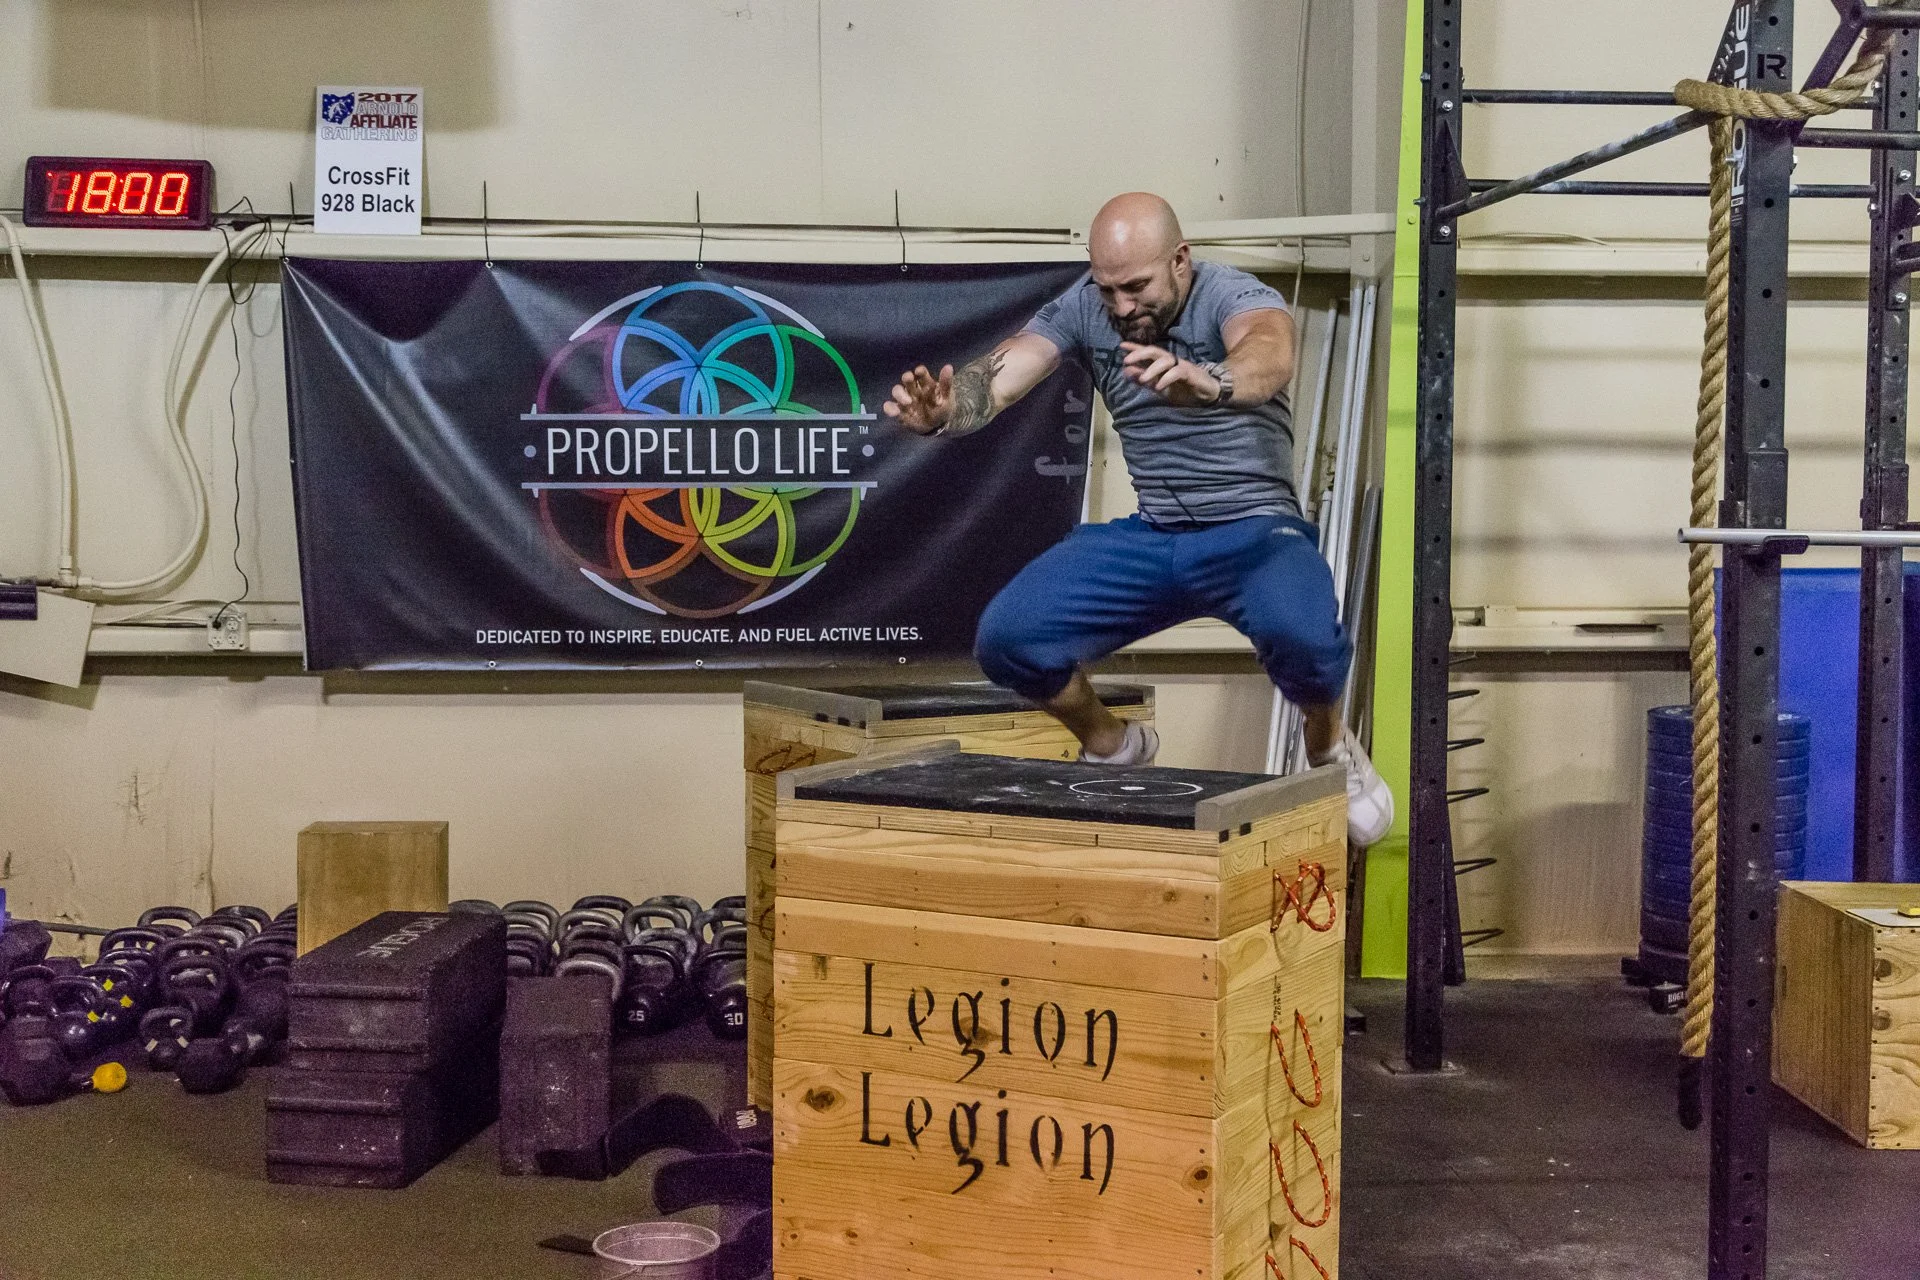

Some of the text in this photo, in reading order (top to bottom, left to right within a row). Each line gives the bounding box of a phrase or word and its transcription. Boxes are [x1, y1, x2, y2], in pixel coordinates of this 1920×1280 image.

[358, 92, 418, 103] 2017
[1731, 4, 1750, 196] ROUE
[356, 102, 418, 115] ARNOLD
[350, 114, 418, 129] AFFILIATE
[320, 126, 418, 141] GATHERING
[328, 165, 410, 186] CrossFit
[66, 171, 189, 215] 18:00
[321, 193, 415, 213] 928 Black
[547, 427, 760, 475] PROPELLO
[774, 427, 850, 474] LIFE
[476, 630, 562, 644] DEDICATED
[566, 630, 585, 643] TO
[738, 628, 771, 642] AND
[776, 628, 815, 642] FUEL
[819, 627, 872, 641] ACTIVE
[876, 627, 923, 641] LIVES.
[628, 1010, 645, 1021] 25
[861, 961, 1119, 1083] Legion
[859, 1071, 1115, 1196] Legion
